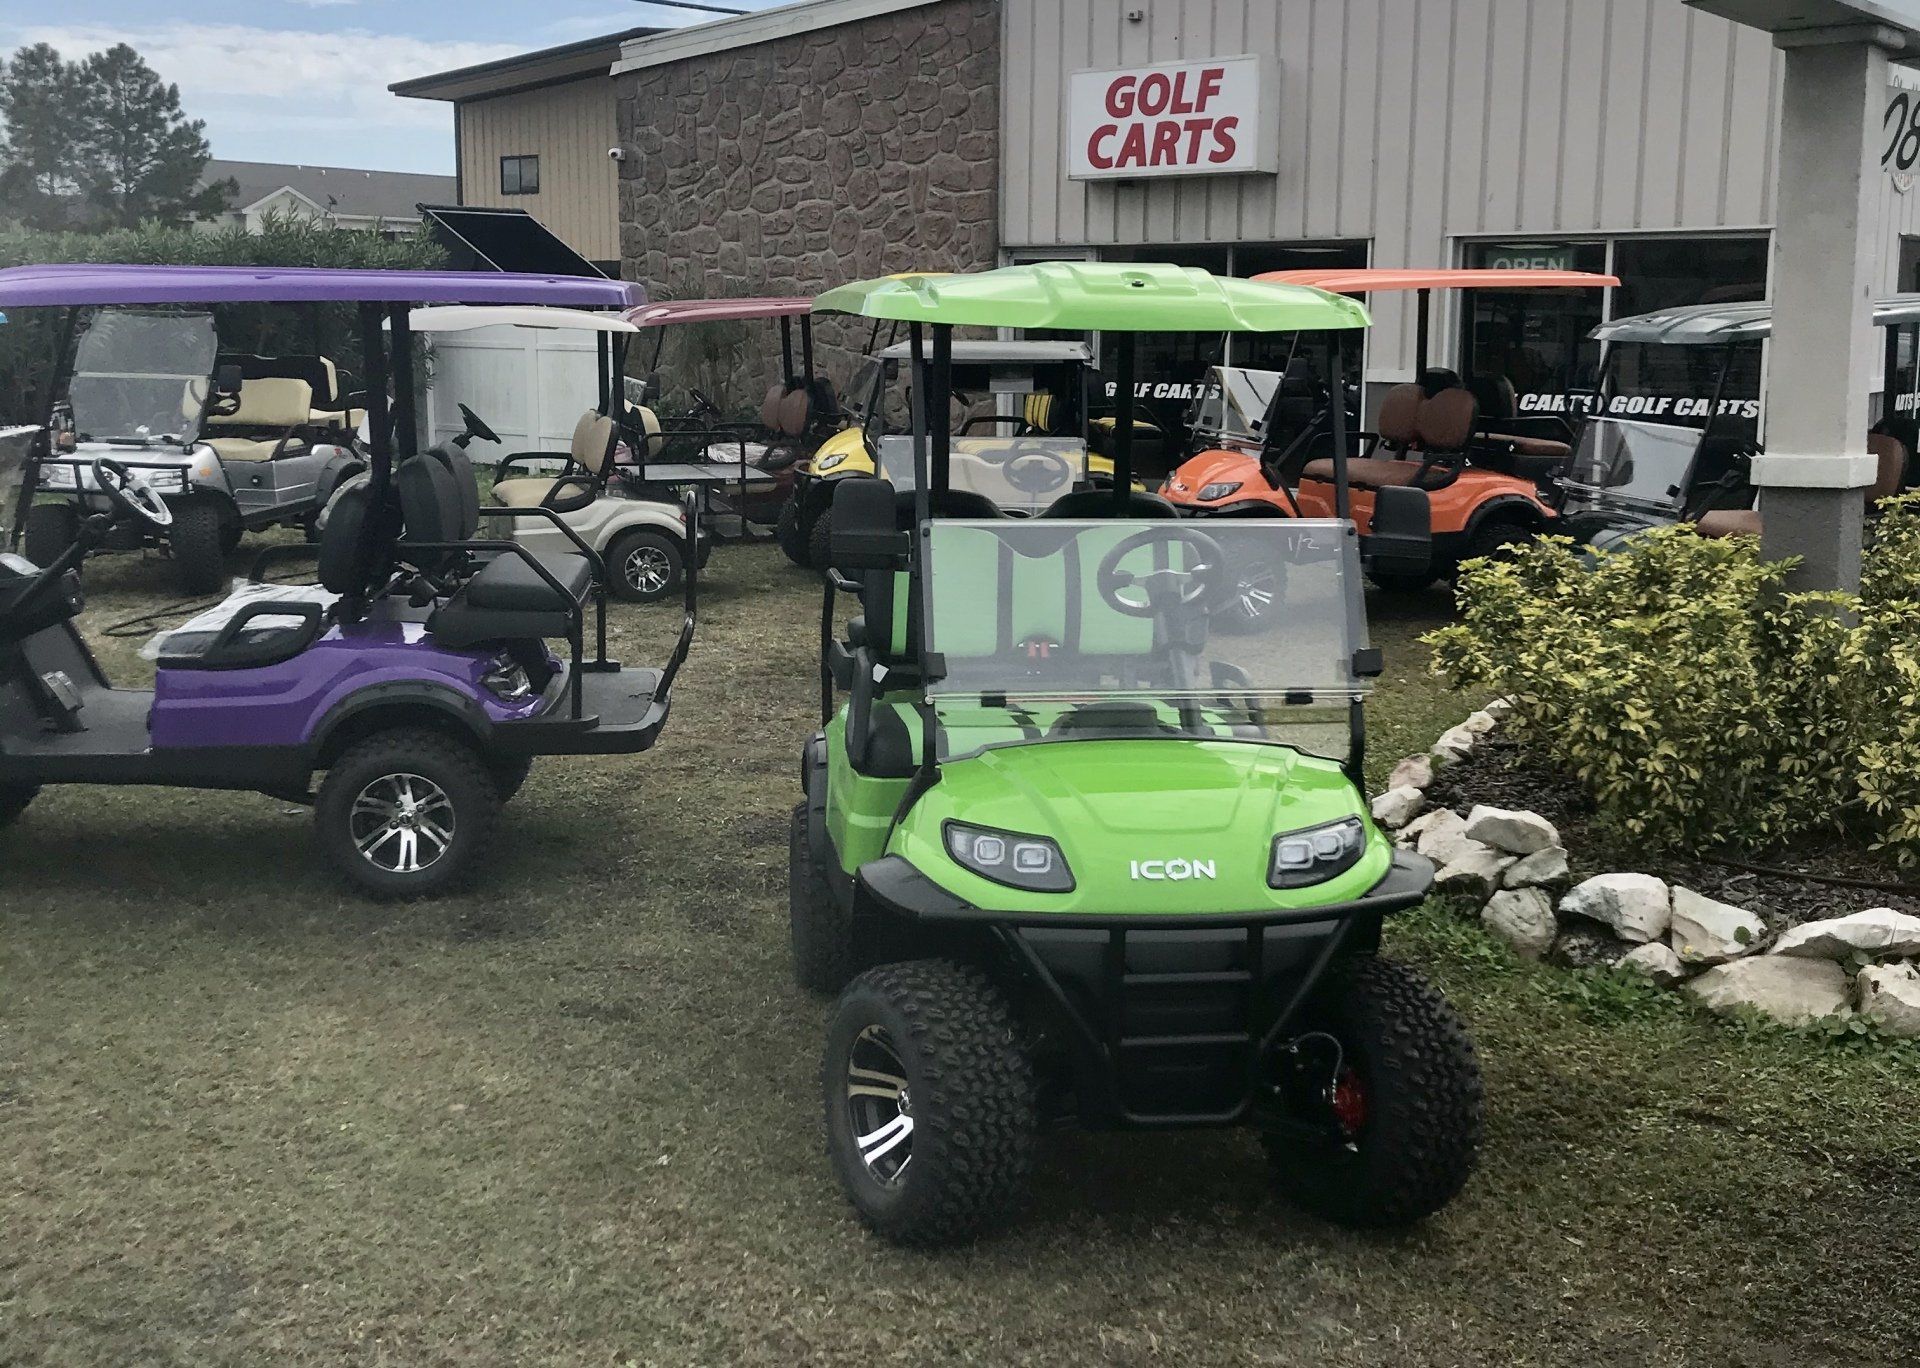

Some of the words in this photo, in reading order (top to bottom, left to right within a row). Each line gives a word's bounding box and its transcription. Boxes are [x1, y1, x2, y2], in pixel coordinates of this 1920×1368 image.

[1105, 68, 1224, 118] GOLF
[1088, 116, 1239, 169] CARTS
[1105, 382, 1152, 398] GLF
[1608, 395, 1672, 414] GOLF
[1130, 857, 1216, 880] ICON
